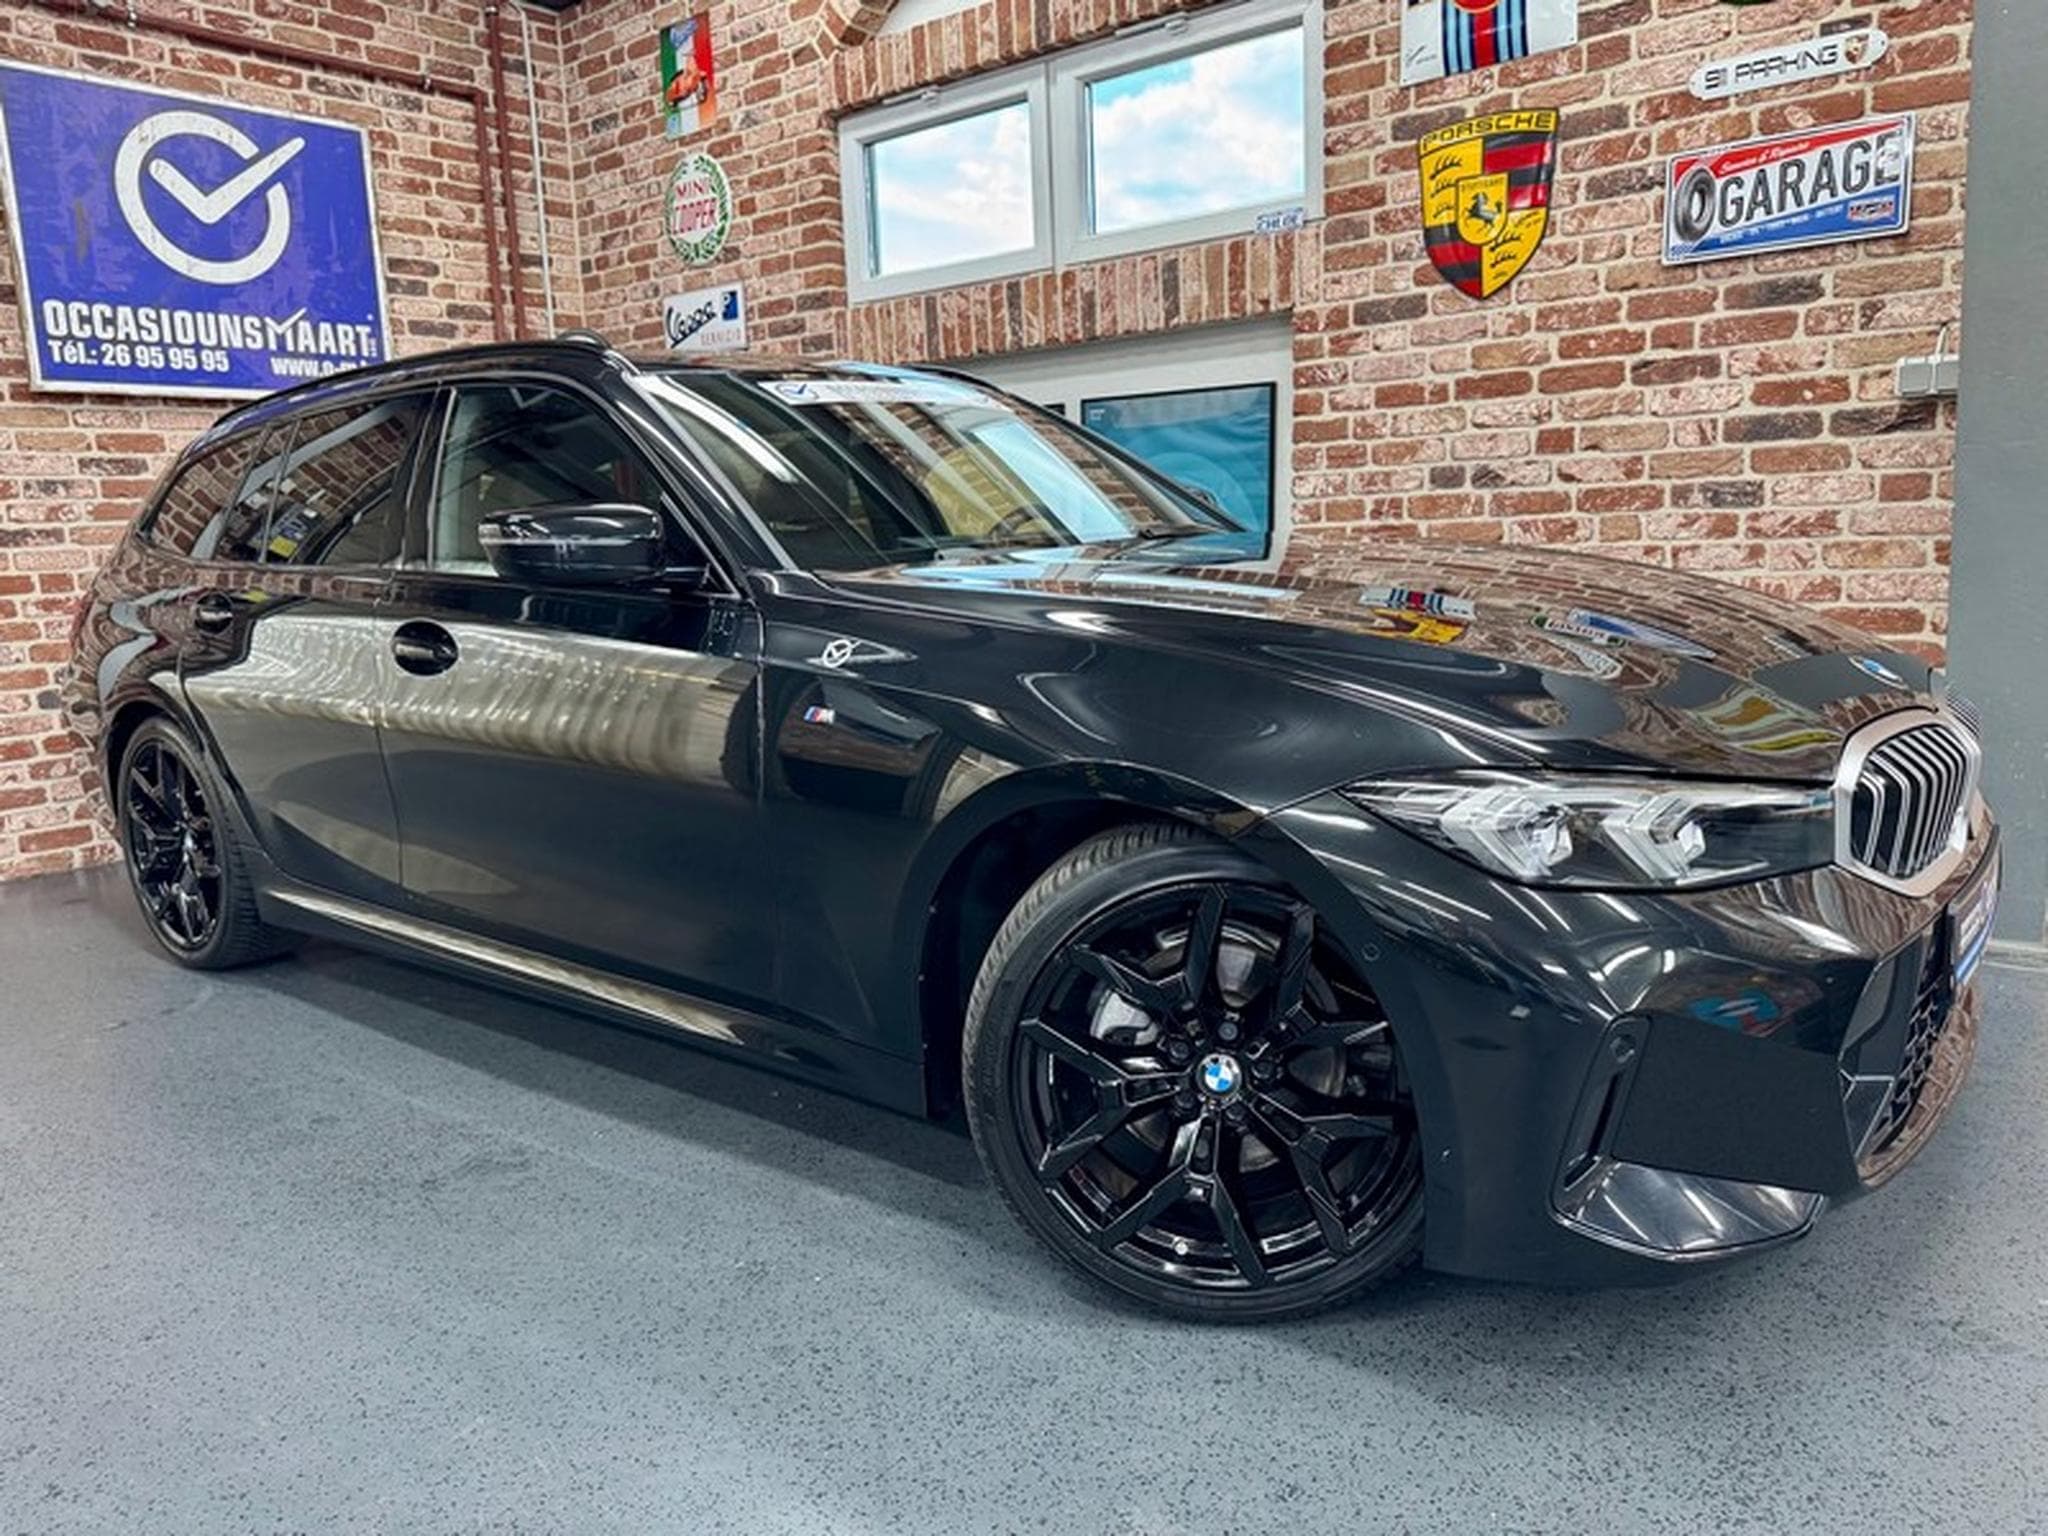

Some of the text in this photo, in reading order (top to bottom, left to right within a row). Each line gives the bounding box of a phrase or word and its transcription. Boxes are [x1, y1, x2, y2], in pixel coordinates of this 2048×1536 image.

[1734, 43, 1839, 84] PARKING
[1422, 111, 1553, 152] PORSCHE
[1718, 130, 1901, 228] GARAGE
[673, 197, 718, 236] COOPER
[42, 300, 371, 357] OCCASIOUNSMAART
[101, 344, 132, 368] 26
[135, 345, 164, 371] 95
[168, 348, 198, 372] 95
[201, 350, 230, 373] 95
